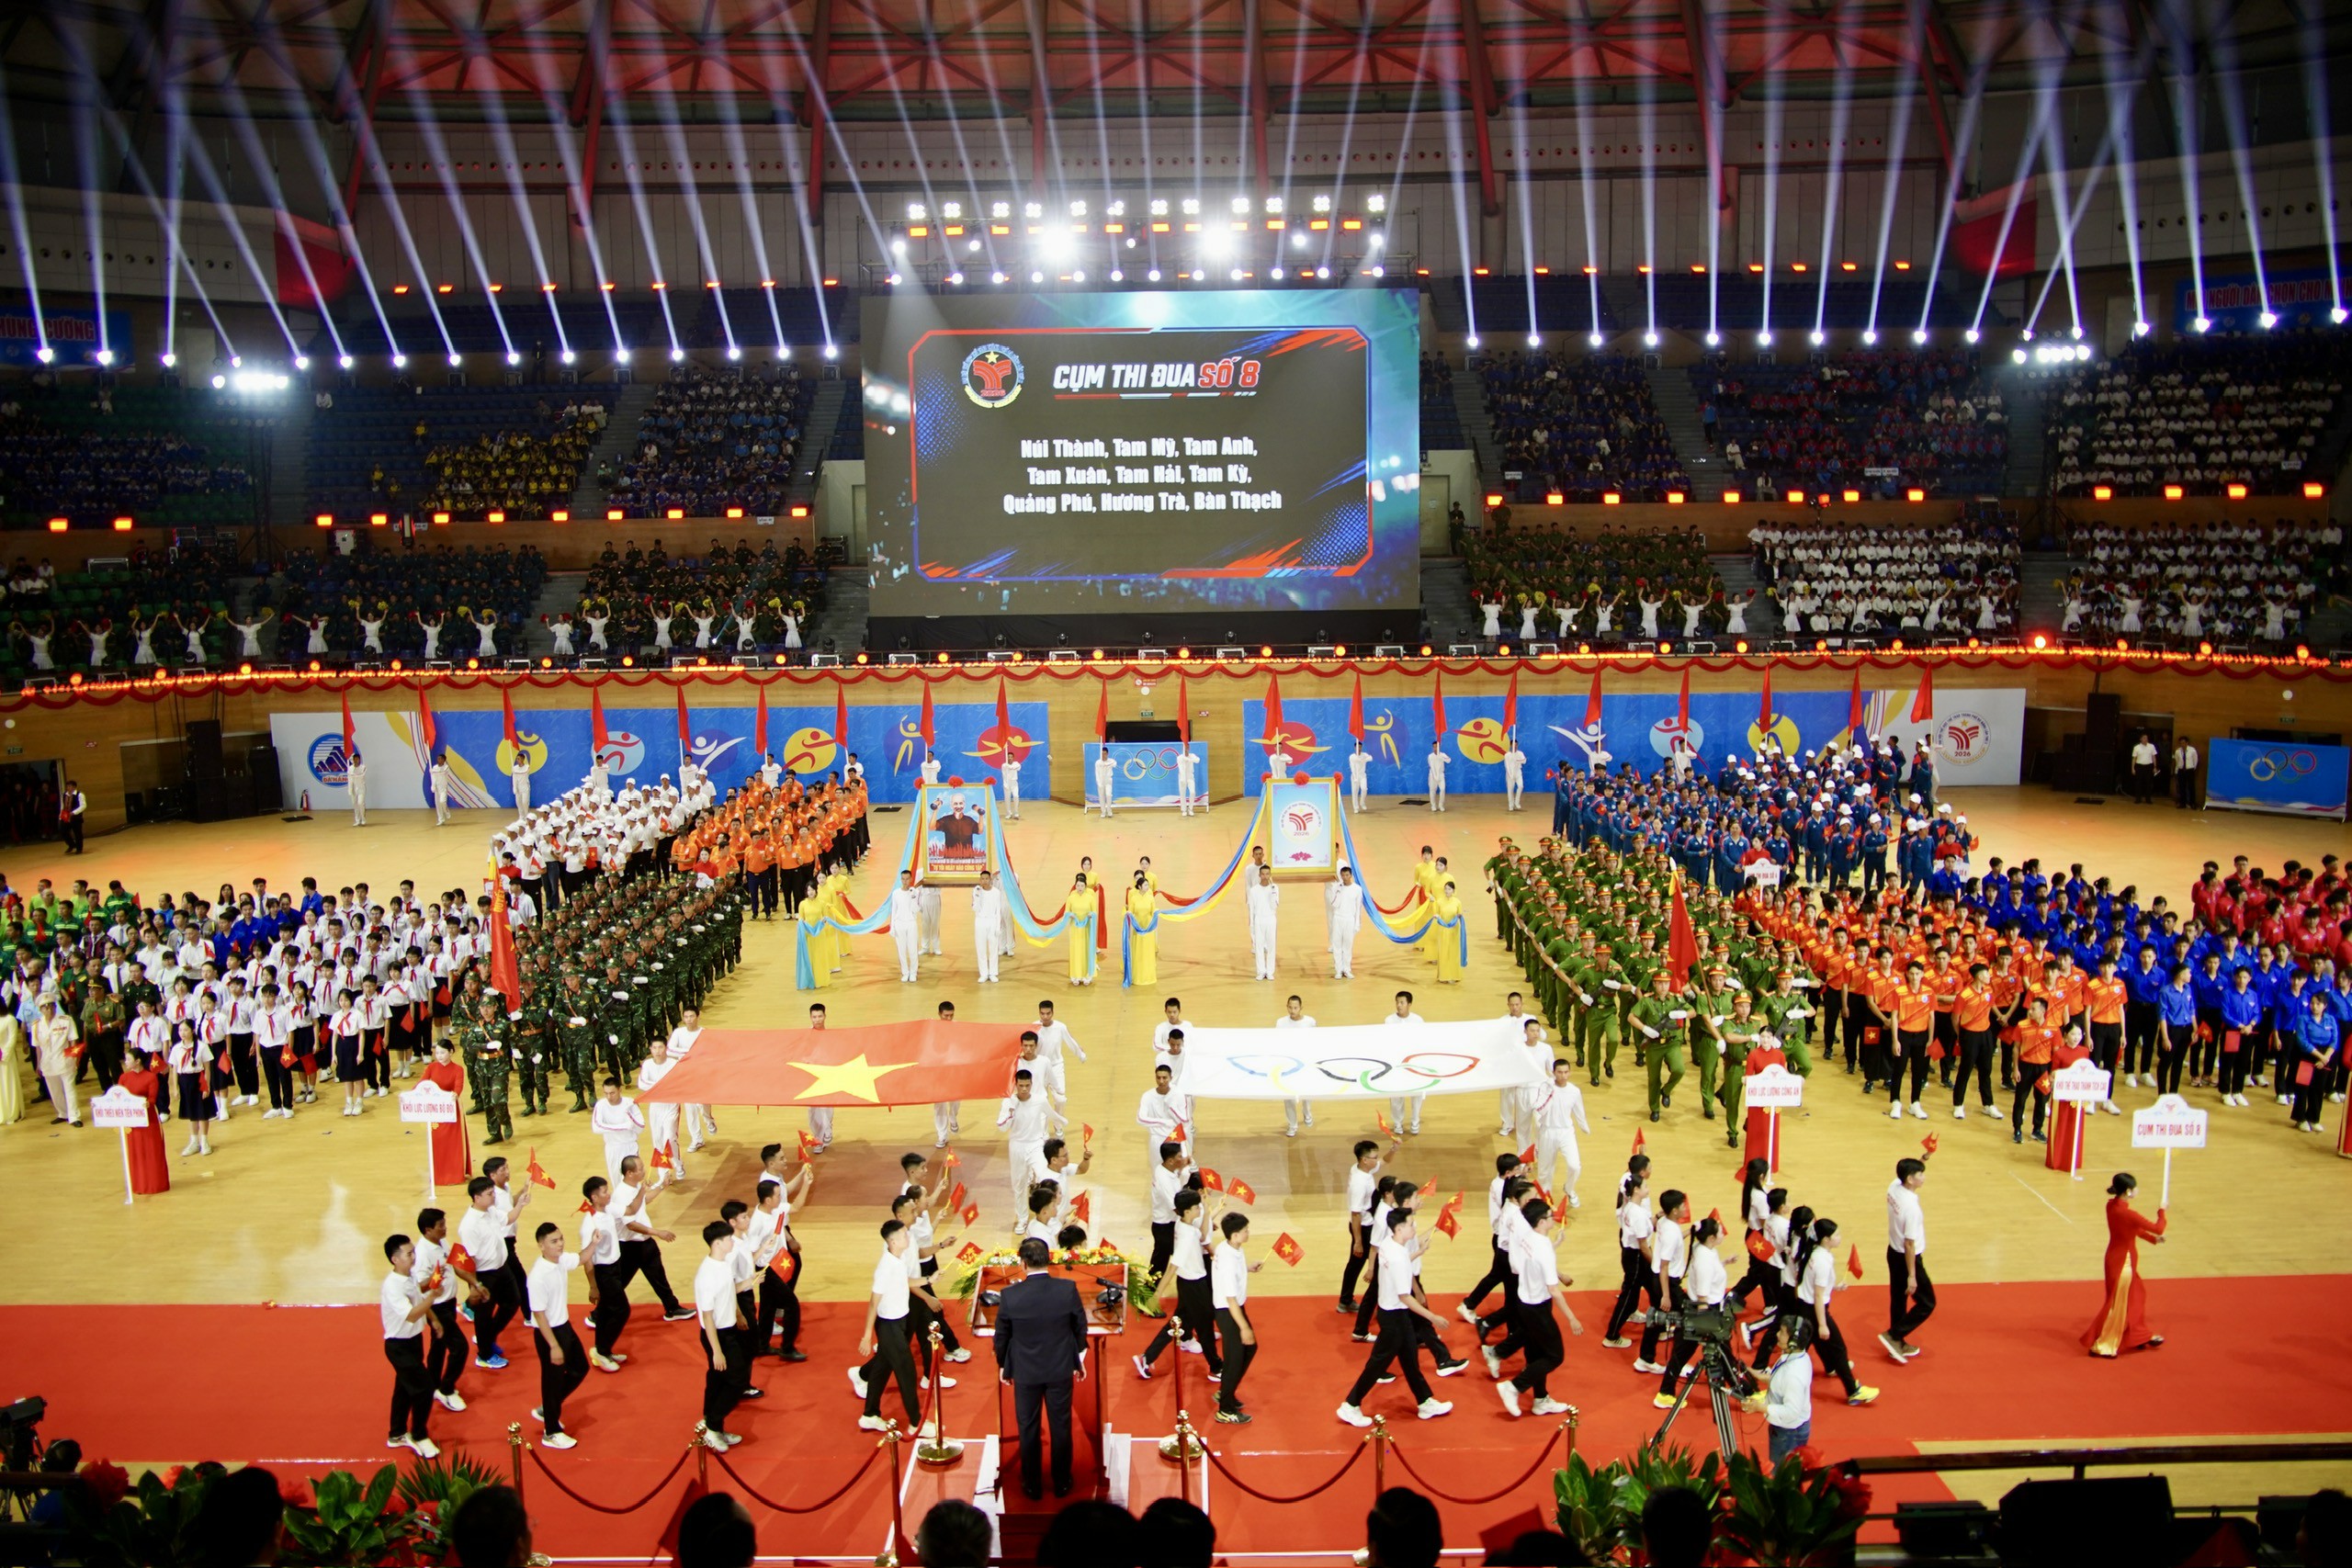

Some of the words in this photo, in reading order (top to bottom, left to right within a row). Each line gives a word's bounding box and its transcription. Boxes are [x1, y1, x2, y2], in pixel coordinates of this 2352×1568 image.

[2298, 279, 2323, 301] CHO
[1053, 365, 1105, 392] CỤM
[1112, 364, 1148, 389] THI
[1150, 364, 1194, 388] ĐUA
[1198, 356, 1242, 389] SỐ
[1238, 360, 1261, 388] 8
[1021, 439, 1049, 457] Núi
[1053, 438, 1109, 458] Thành,
[1113, 438, 1147, 457] Tam
[1151, 437, 1180, 457] Mỹ,
[1183, 436, 1217, 457] Tam
[1221, 436, 1258, 457] Anh,
[1027, 467, 1061, 485] Tam
[1065, 466, 1111, 485] Xuân,
[1114, 466, 1148, 484] Tam
[1154, 464, 1185, 484] Hải,
[1189, 464, 1223, 482] Tam
[1003, 492, 1057, 514] Quảng
[1061, 493, 1097, 513] Phú,
[1101, 492, 1154, 513] Hương
[1158, 491, 1190, 512] Trà,
[1193, 491, 1227, 510] Bàn
[1230, 491, 1283, 513] Thạch
[2137, 1123, 2153, 1138] CỤM
[2156, 1124, 2166, 1135] THI
[2168, 1123, 2182, 1135] ĐUA
[2185, 1120, 2195, 1135] SỐ
